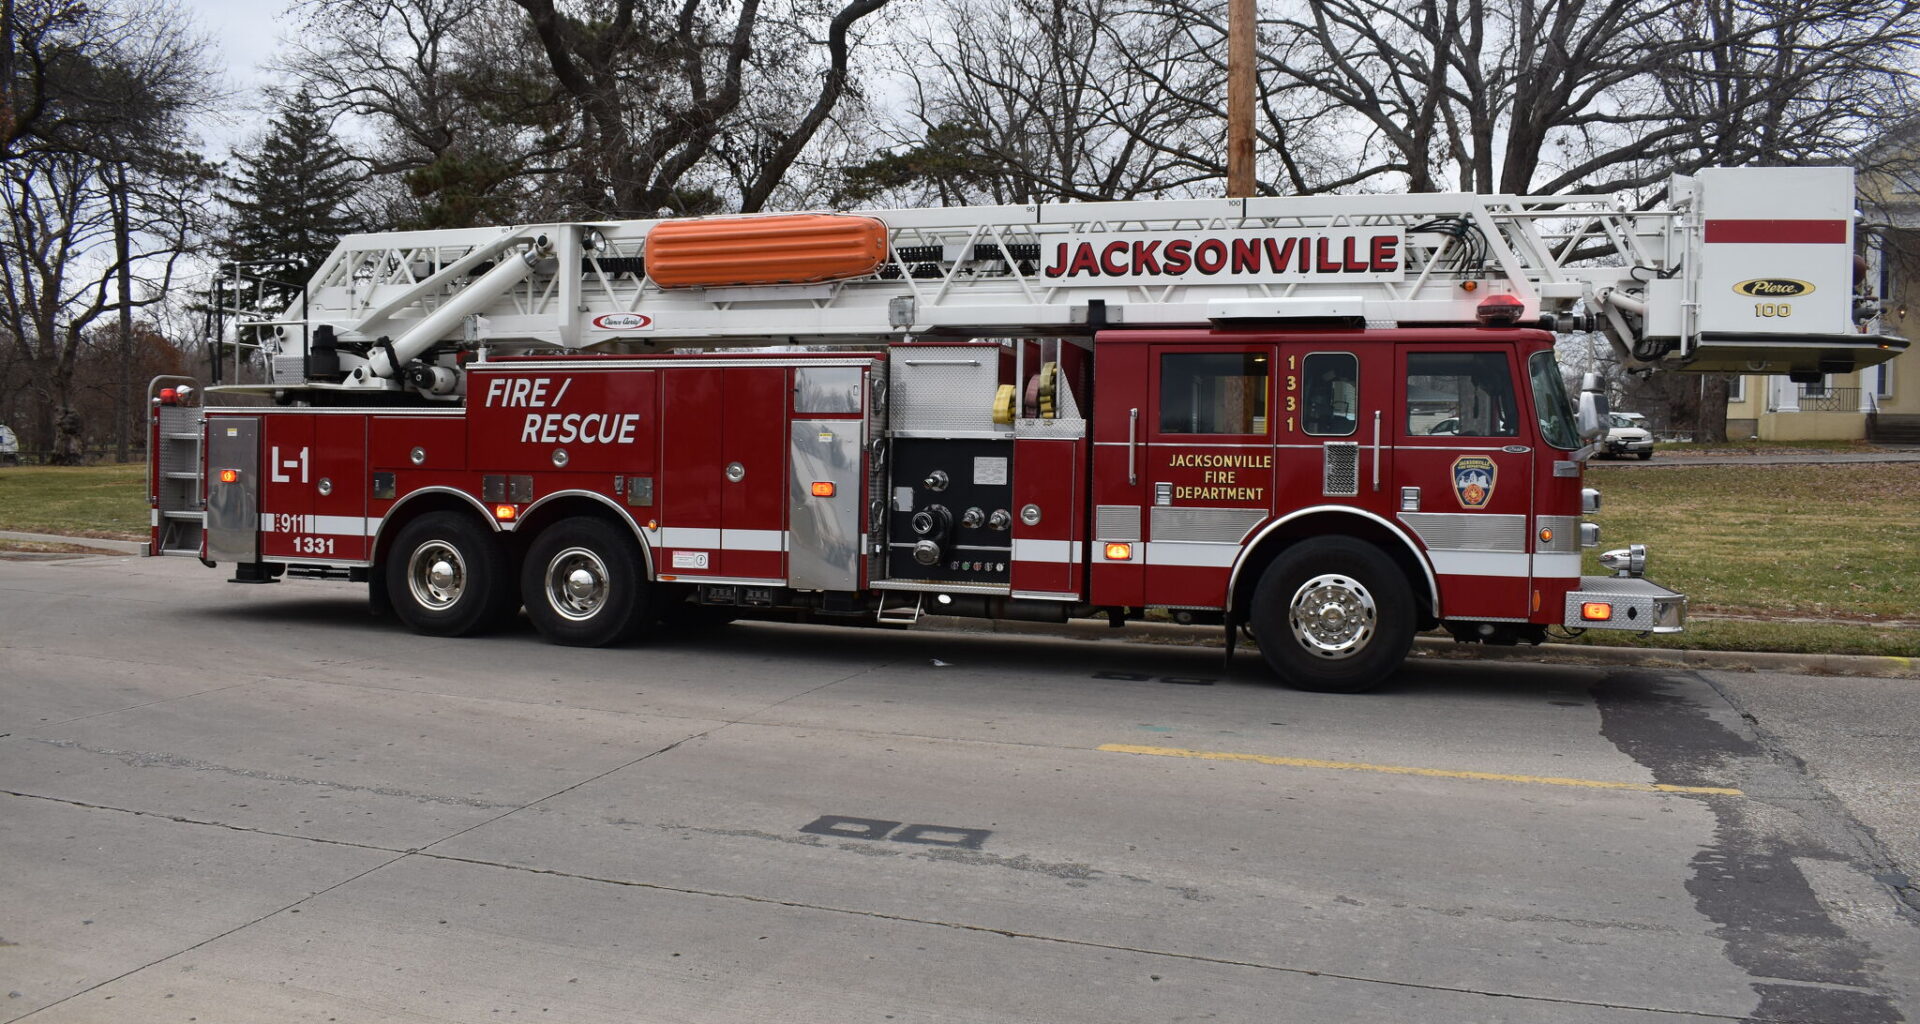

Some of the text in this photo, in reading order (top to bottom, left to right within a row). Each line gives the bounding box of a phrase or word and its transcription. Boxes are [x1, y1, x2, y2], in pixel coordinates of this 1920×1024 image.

[1045, 235, 1399, 278] JACKSONVILLE
[1751, 280, 1798, 296] Pierce
[1754, 303, 1792, 318] 100
[1286, 355, 1297, 432] 1331
[521, 413, 640, 444] RESCUE
[271, 446, 309, 484] L-1
[1169, 454, 1272, 468] JACKSONVILLE
[1204, 471, 1236, 484] FIRE
[1176, 486, 1264, 500] DEPARTMENT
[281, 513, 303, 534] 911
[293, 537, 335, 555] 1331
